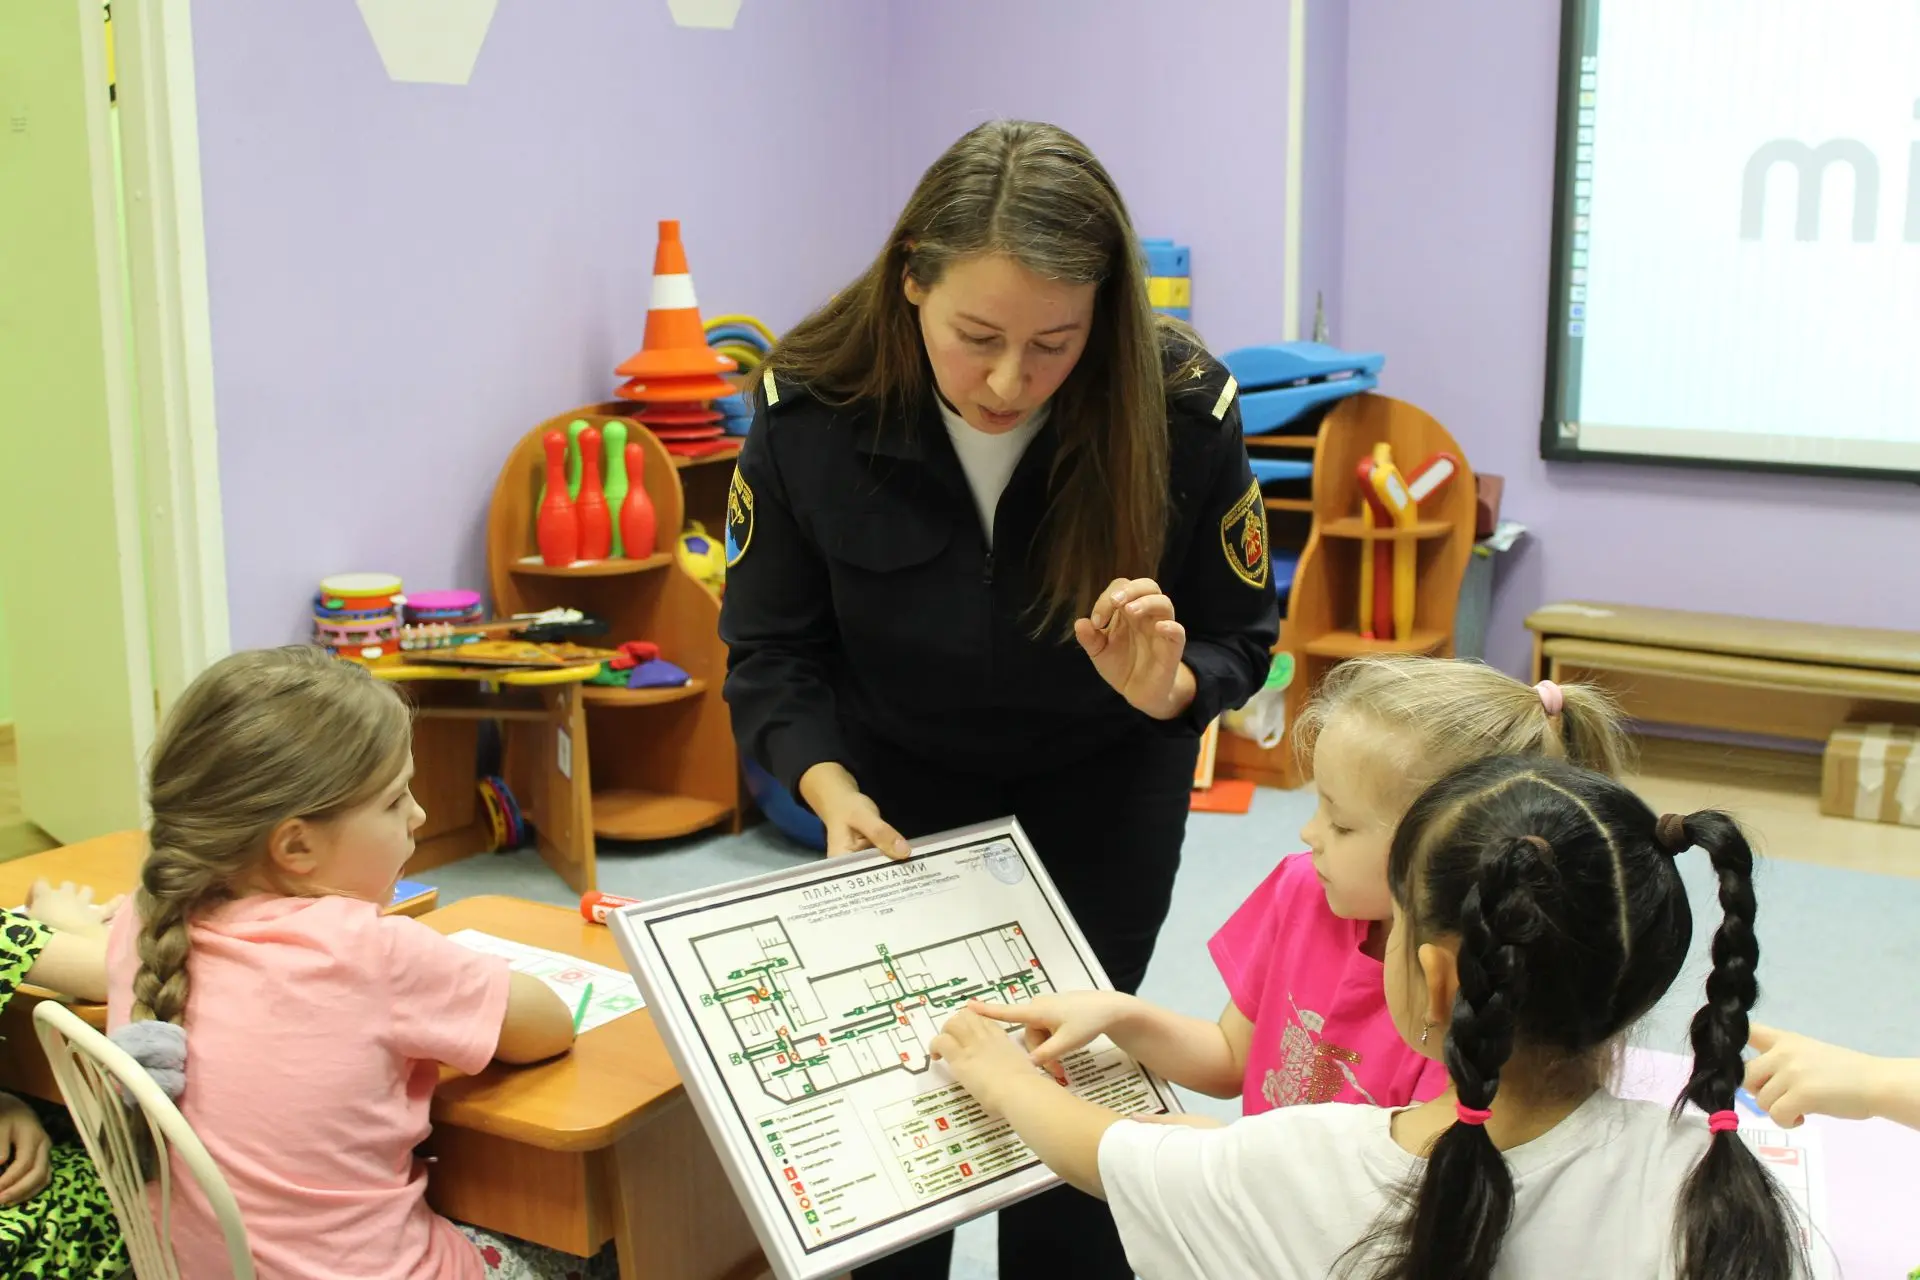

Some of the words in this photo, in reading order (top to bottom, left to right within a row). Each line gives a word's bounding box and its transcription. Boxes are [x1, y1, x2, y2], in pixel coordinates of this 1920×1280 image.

[802, 883, 842, 901] ПЛАН
[846, 861, 927, 889] ЭВАКУАЦИИ
[892, 1136, 901, 1147] 1
[912, 1134, 930, 1149] 01
[903, 1160, 915, 1174] 2
[914, 1182, 926, 1195] 3
